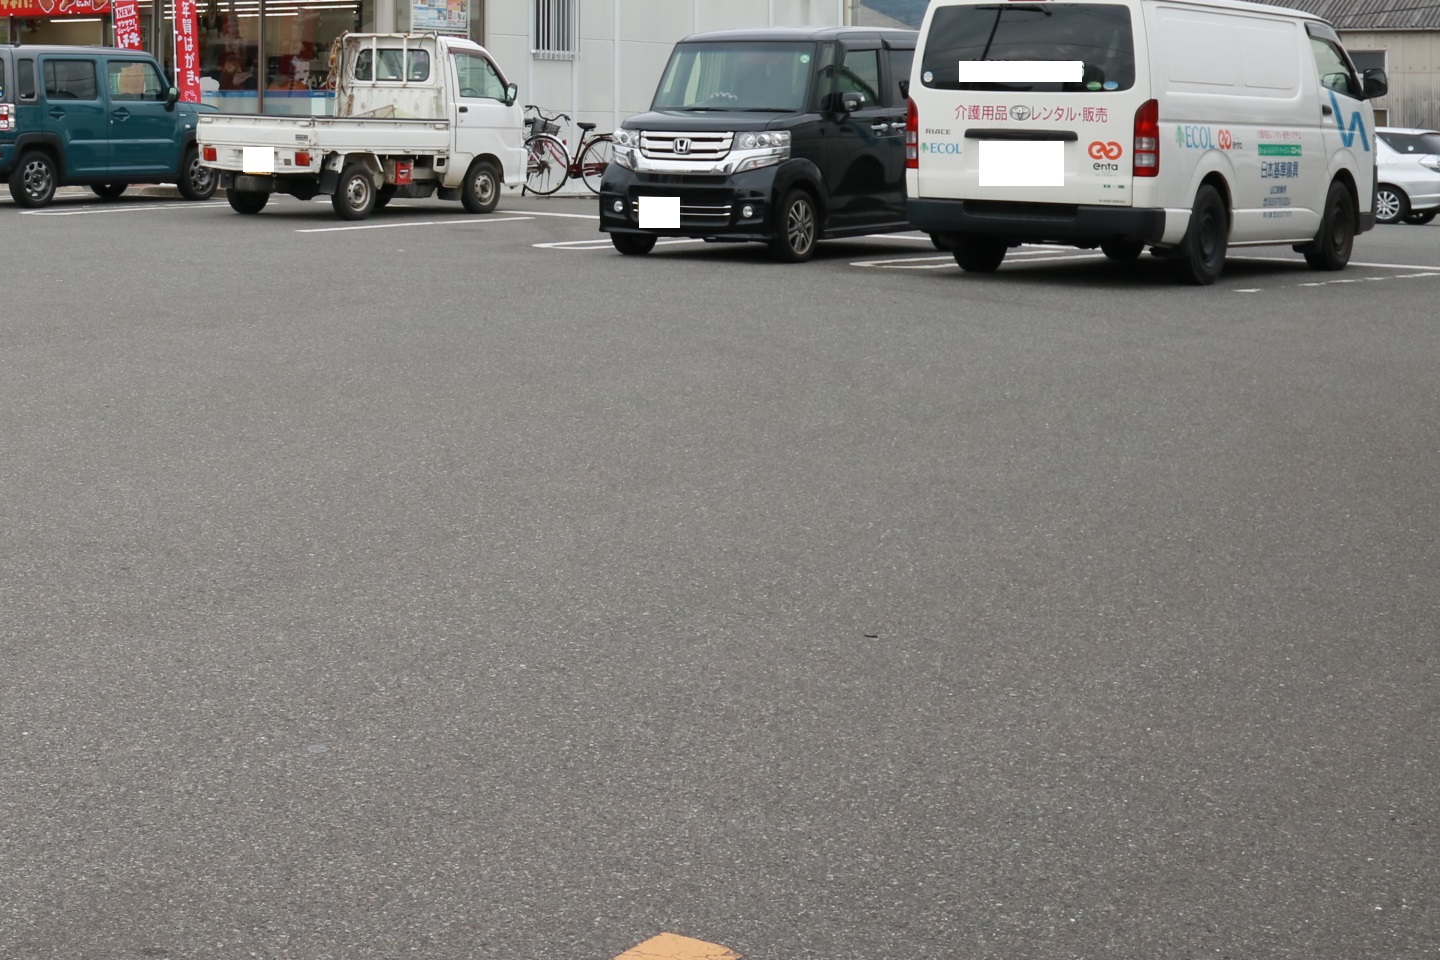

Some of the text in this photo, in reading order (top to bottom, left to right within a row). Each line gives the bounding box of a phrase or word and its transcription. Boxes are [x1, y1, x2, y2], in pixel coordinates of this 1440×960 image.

[117, 6, 133, 18] NEW
[181, 1, 195, 86] 年賀はがき
[954, 105, 1108, 123] 介護用品 レンタル・販売
[1185, 126, 1215, 149] ECOL
[930, 142, 962, 155] ECOL
[1093, 162, 1118, 171] enta
